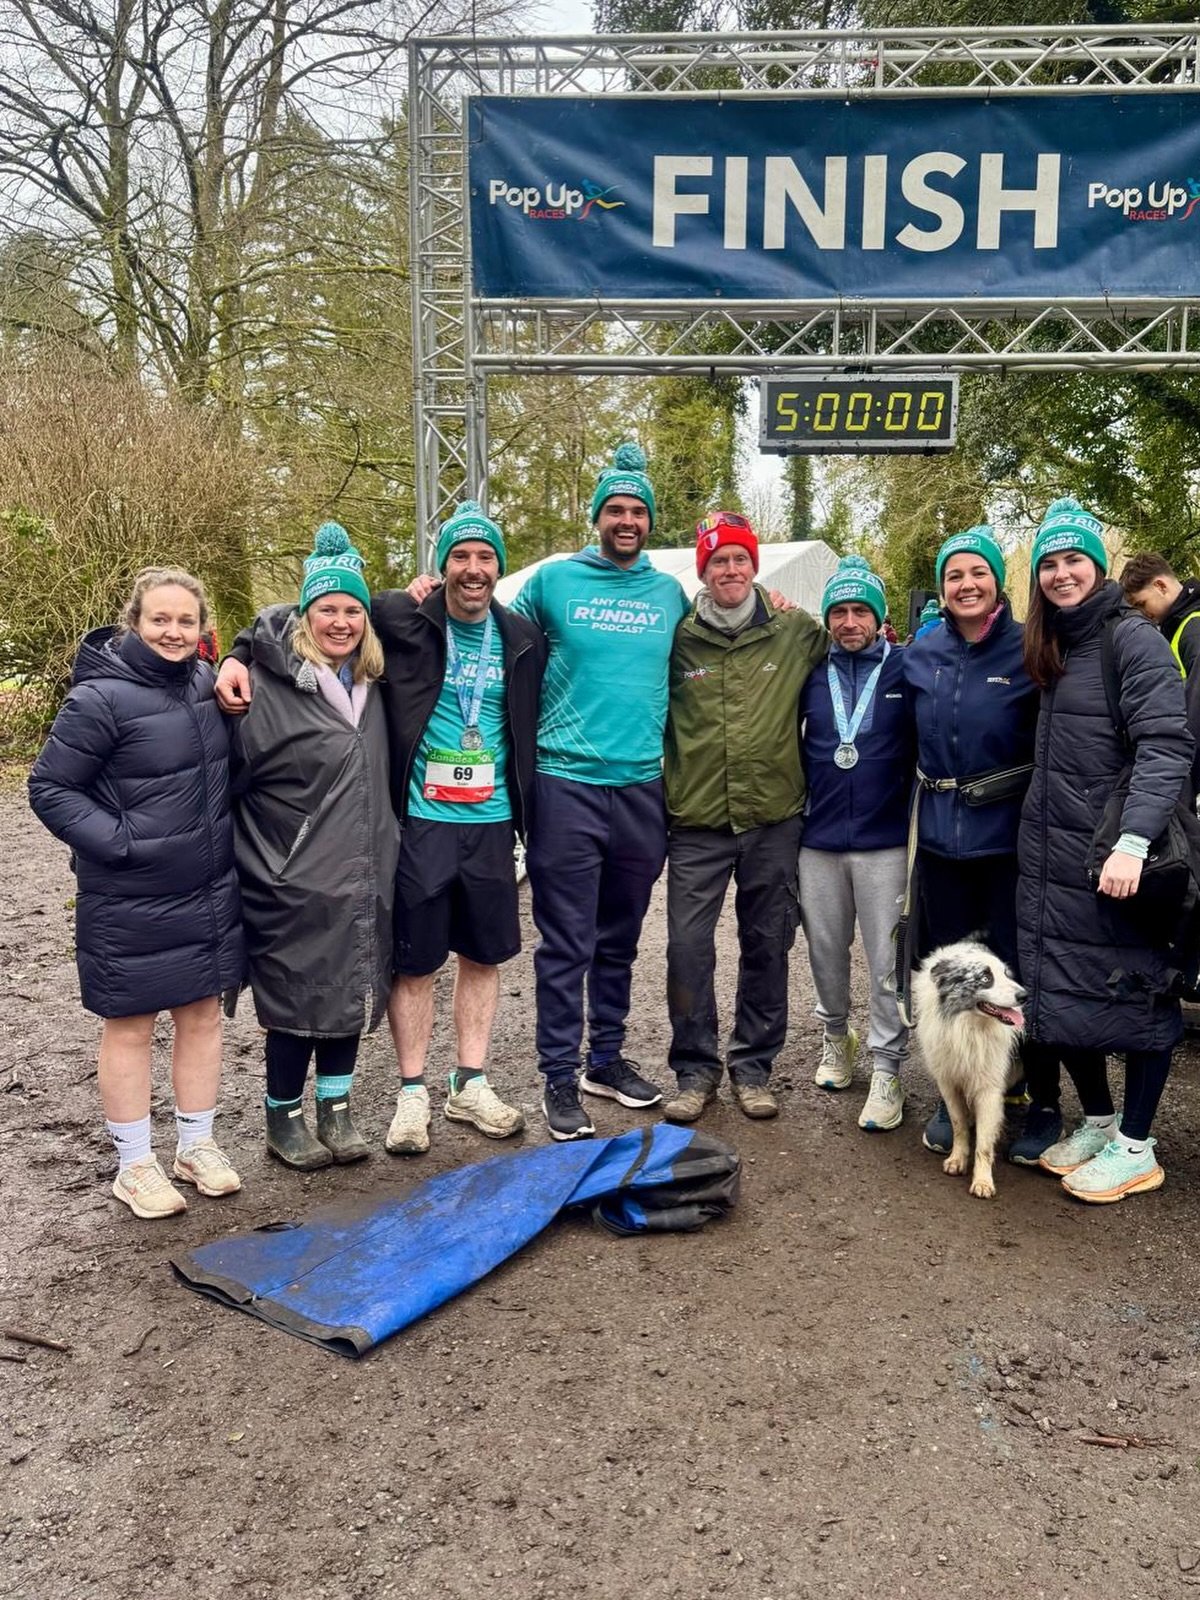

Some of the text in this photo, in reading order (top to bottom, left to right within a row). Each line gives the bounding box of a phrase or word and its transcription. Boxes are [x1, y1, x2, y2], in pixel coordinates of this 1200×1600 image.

[489, 180, 584, 215] Pop Up
[652, 151, 1061, 252] FINISH
[1088, 181, 1188, 215] Pop Up
[529, 209, 566, 219] RACES
[1129, 211, 1167, 220] RACES
[775, 392, 945, 431] 5:00:00
[1040, 537, 1080, 551] RUNDAY
[590, 598, 650, 610] ANY GIVEN
[574, 607, 660, 626] RUNDAY
[592, 622, 646, 634] PODCAST
[453, 766, 473, 780] 69
